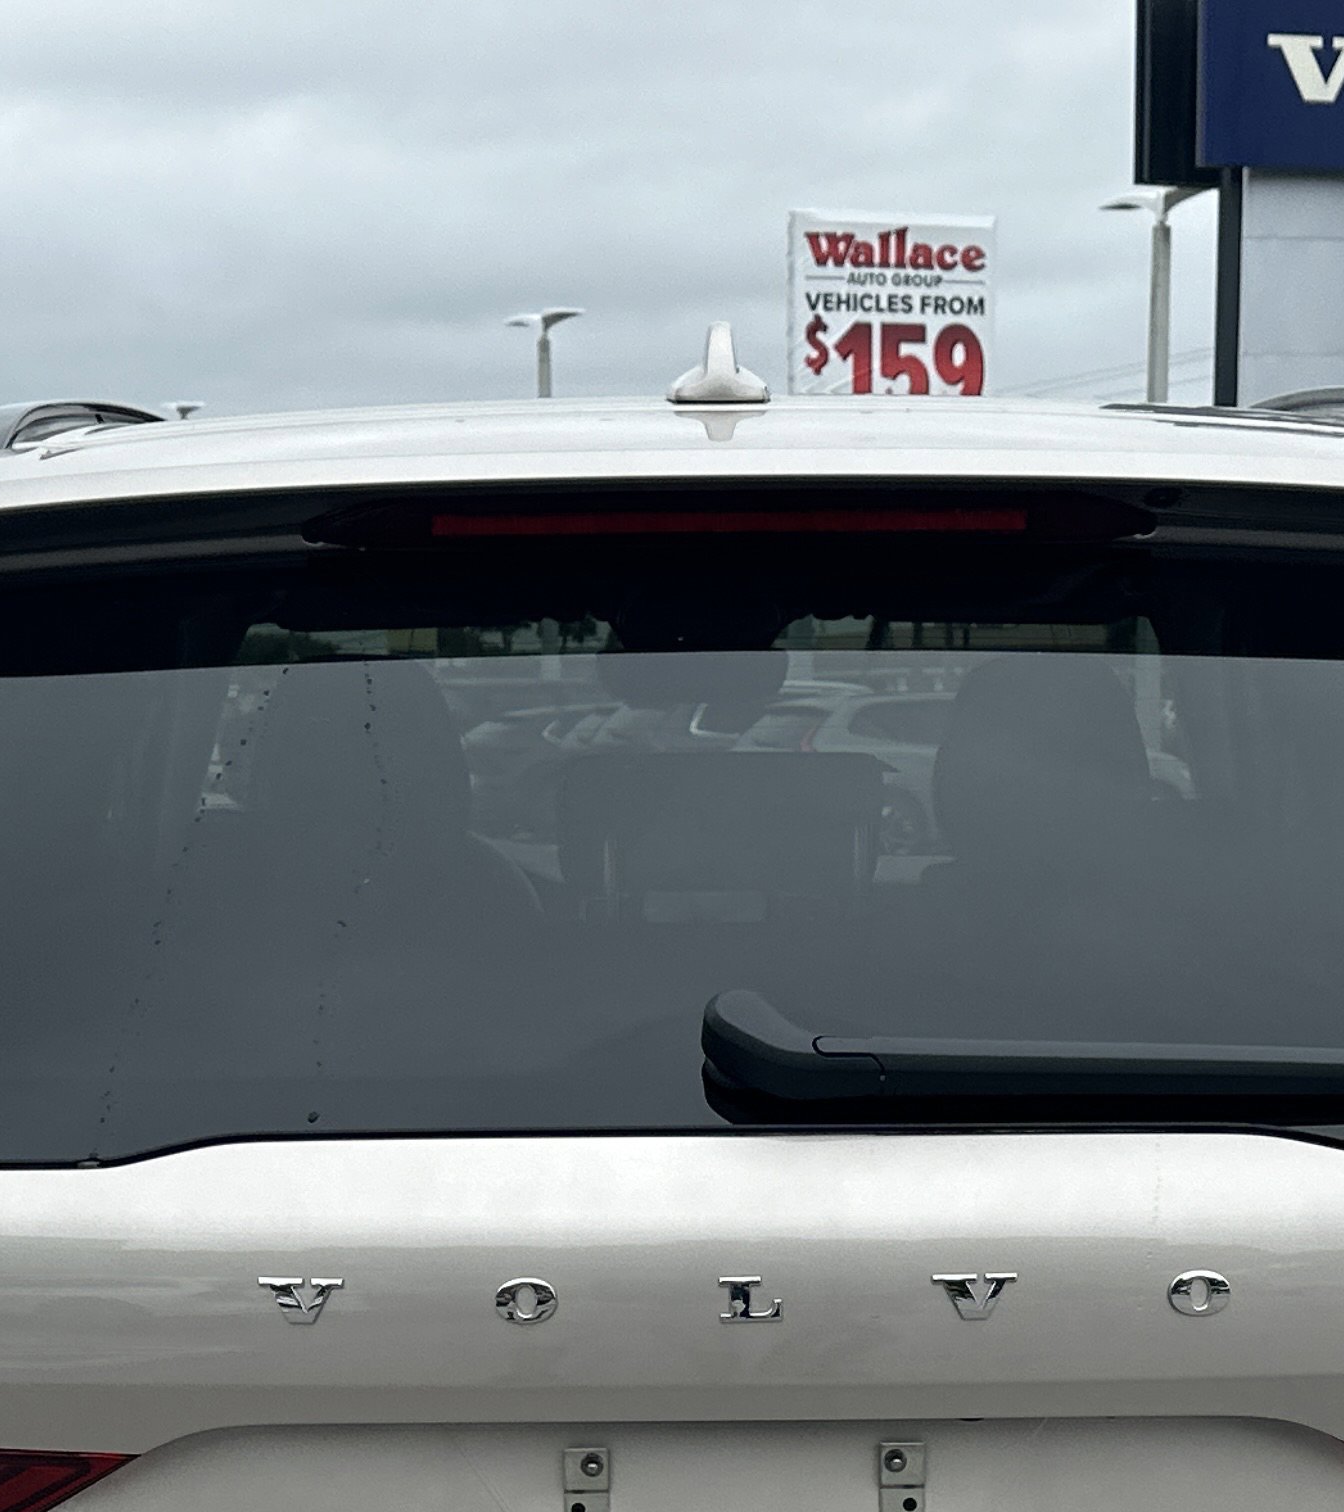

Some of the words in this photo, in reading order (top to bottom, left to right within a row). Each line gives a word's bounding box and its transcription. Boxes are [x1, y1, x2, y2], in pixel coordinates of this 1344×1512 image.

[804, 226, 986, 272] Wallace
[846, 272, 887, 286] AUTO
[891, 273, 943, 288] GROUP
[805, 291, 913, 314] VEHICLES
[920, 295, 985, 316] FROM
[804, 313, 984, 396] $159
[257, 1269, 1231, 1326] VOLVO
